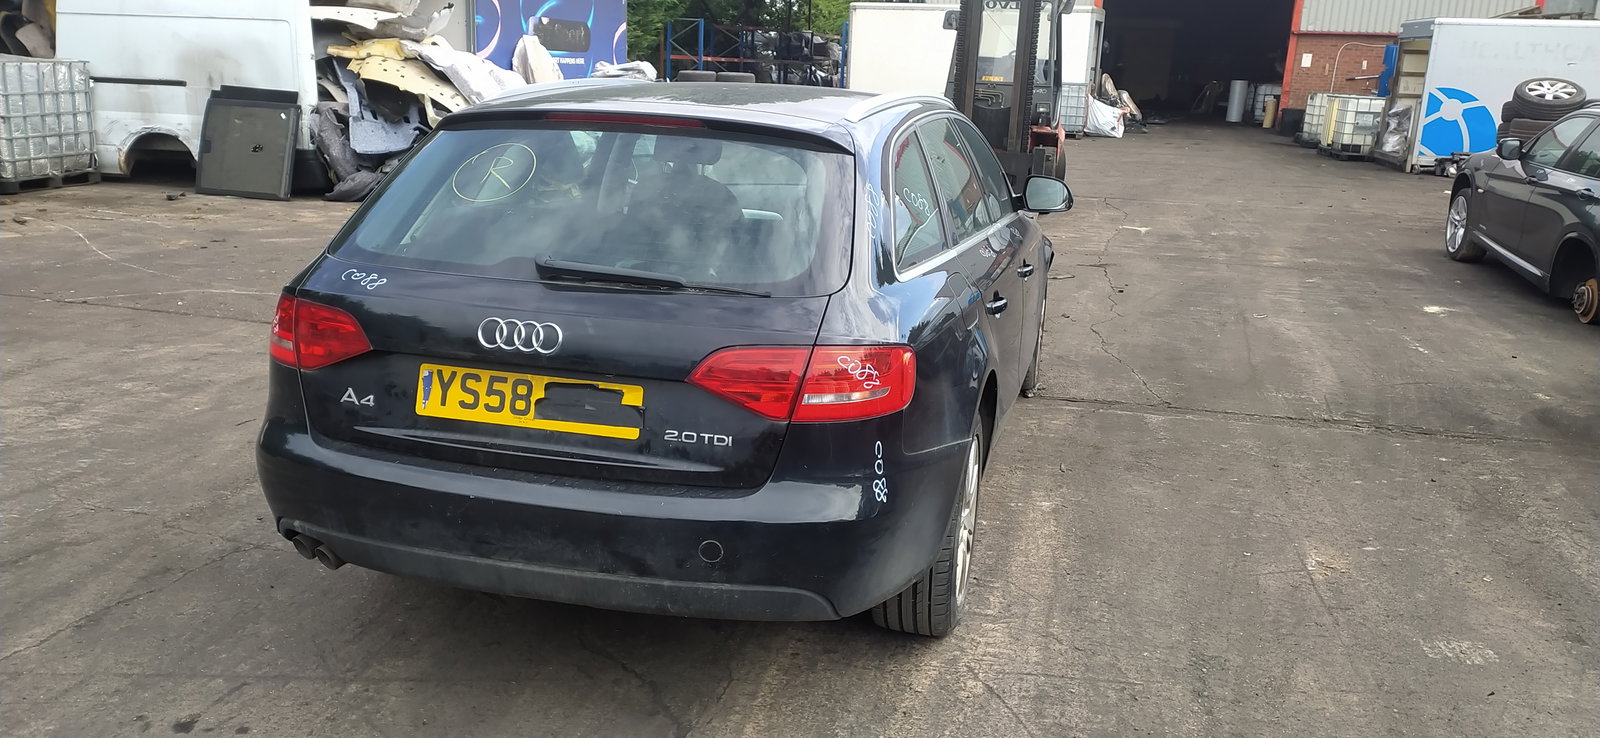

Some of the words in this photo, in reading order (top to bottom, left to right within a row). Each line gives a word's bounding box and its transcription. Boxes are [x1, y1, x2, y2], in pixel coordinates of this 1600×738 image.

[480, 155, 513, 190] R
[339, 386, 376, 408] A4
[435, 368, 534, 418] YS58
[663, 429, 697, 443] 2.0
[701, 433, 733, 447] TDI
